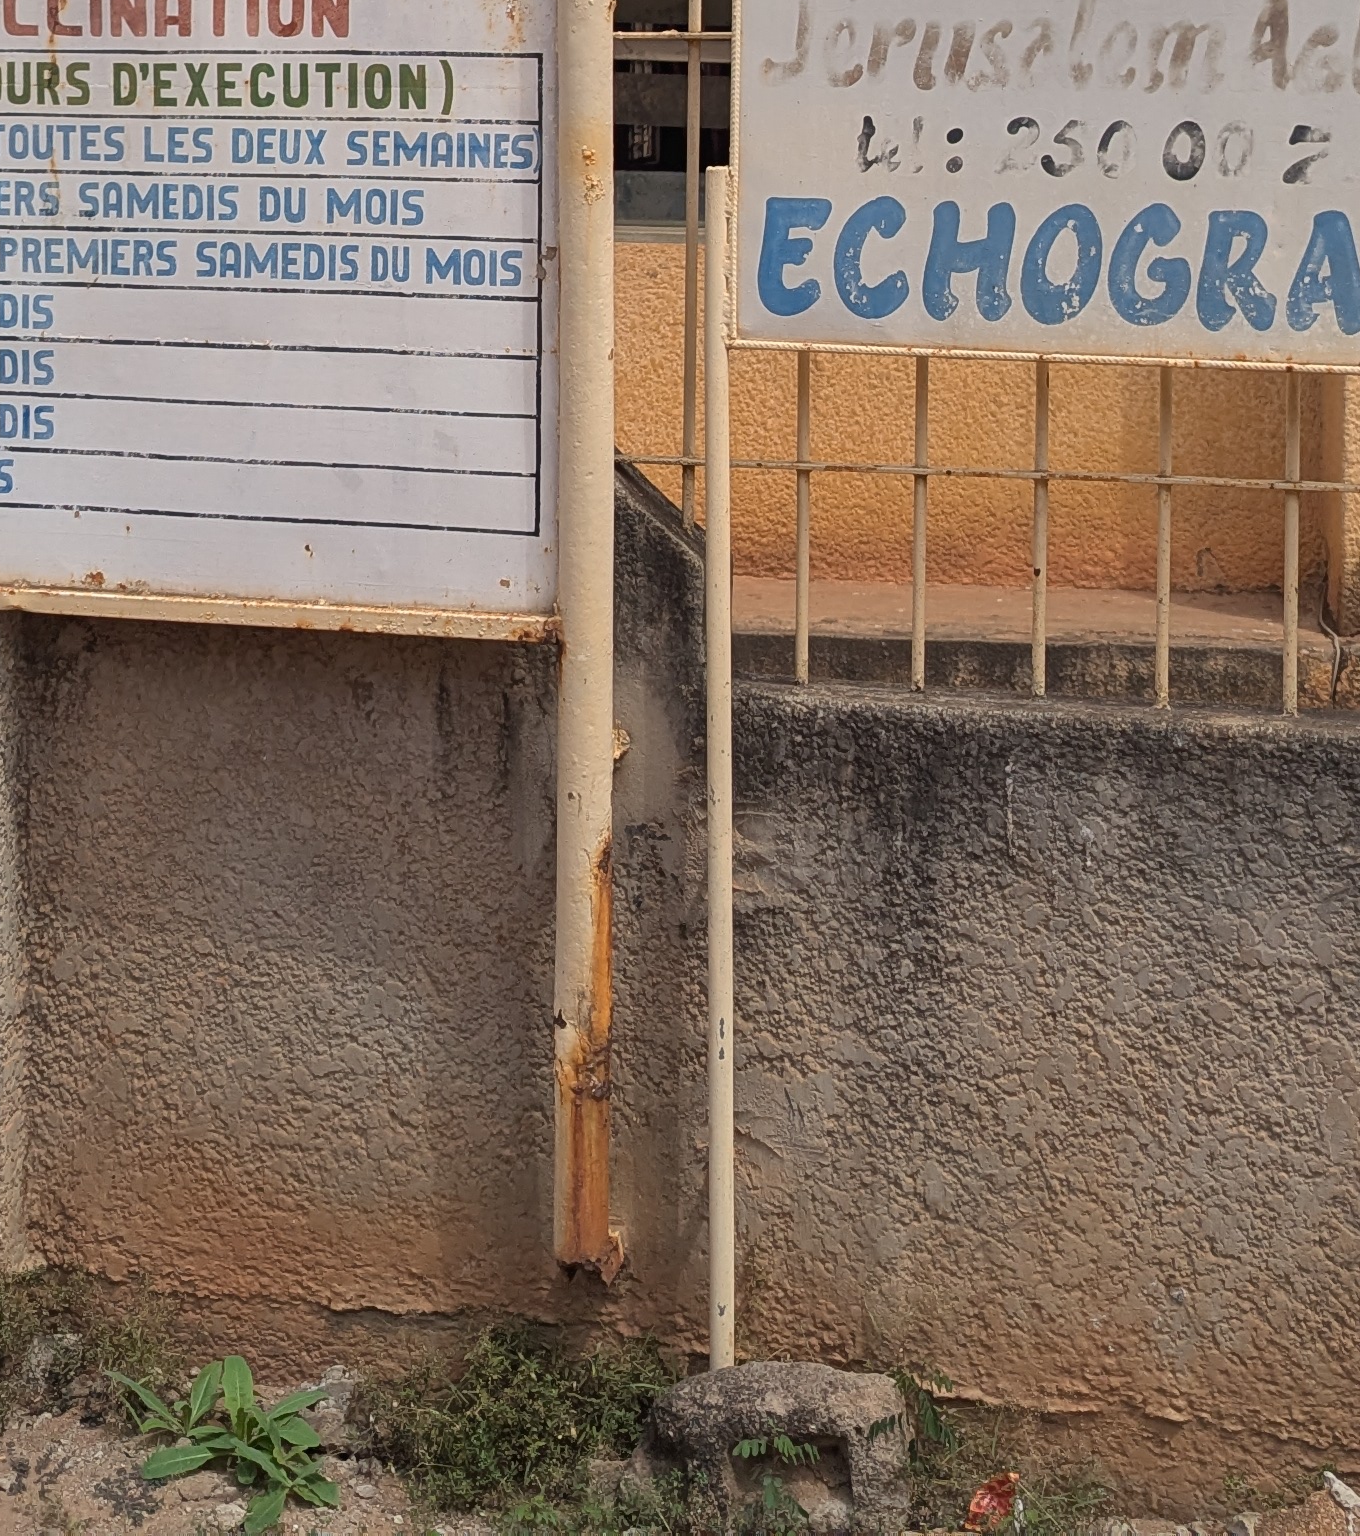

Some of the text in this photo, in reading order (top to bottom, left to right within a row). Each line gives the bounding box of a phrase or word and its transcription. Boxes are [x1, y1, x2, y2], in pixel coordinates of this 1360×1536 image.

[112, 58, 456, 117] D'EXECUTION)
[143, 126, 215, 164] LES
[230, 127, 328, 166] DEUX
[346, 130, 540, 173] SEMAINES)
[993, 115, 1137, 180] 250
[1161, 119, 1254, 182] 00
[78, 182, 240, 223] SAMEDIS
[259, 186, 307, 225] DU
[326, 187, 425, 227] MOIS
[196, 240, 360, 283] SAMEDIS
[370, 245, 411, 284] DU
[425, 247, 523, 288] MOIS
